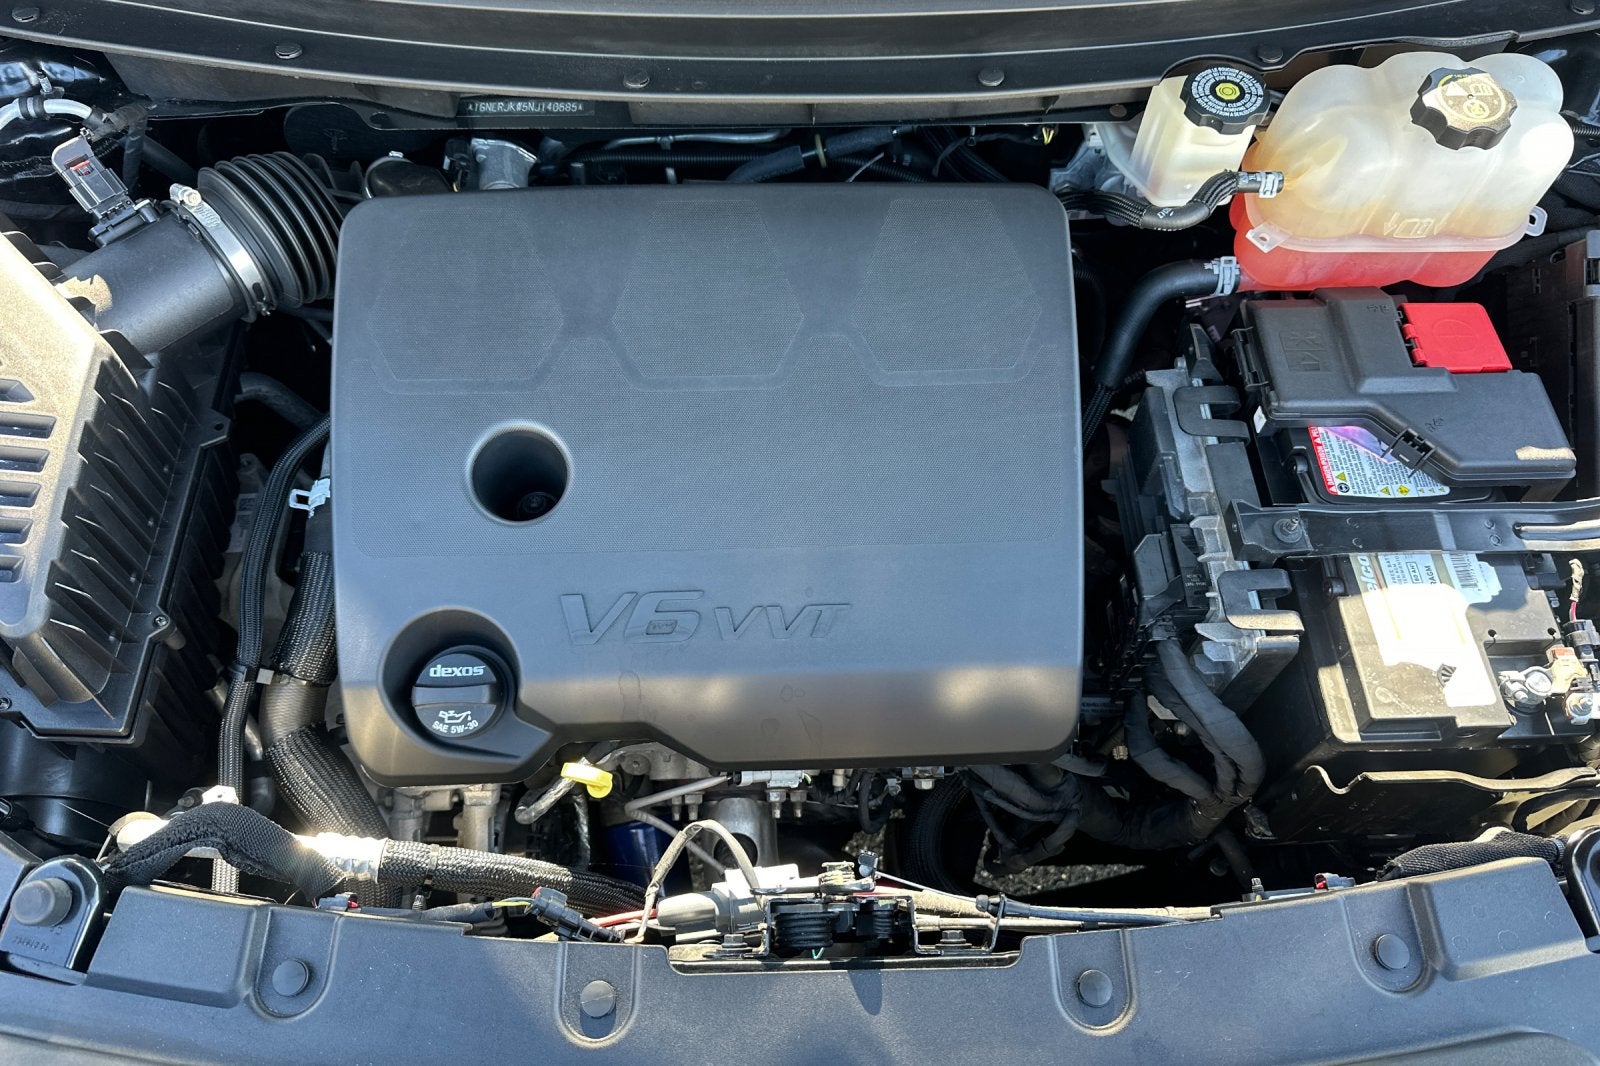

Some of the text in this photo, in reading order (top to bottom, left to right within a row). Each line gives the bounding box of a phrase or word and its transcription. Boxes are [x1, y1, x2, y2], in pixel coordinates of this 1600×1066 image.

[560, 590, 705, 646] V6
[429, 664, 486, 678] dexos
[432, 720, 479, 734] SAE 5W-30
